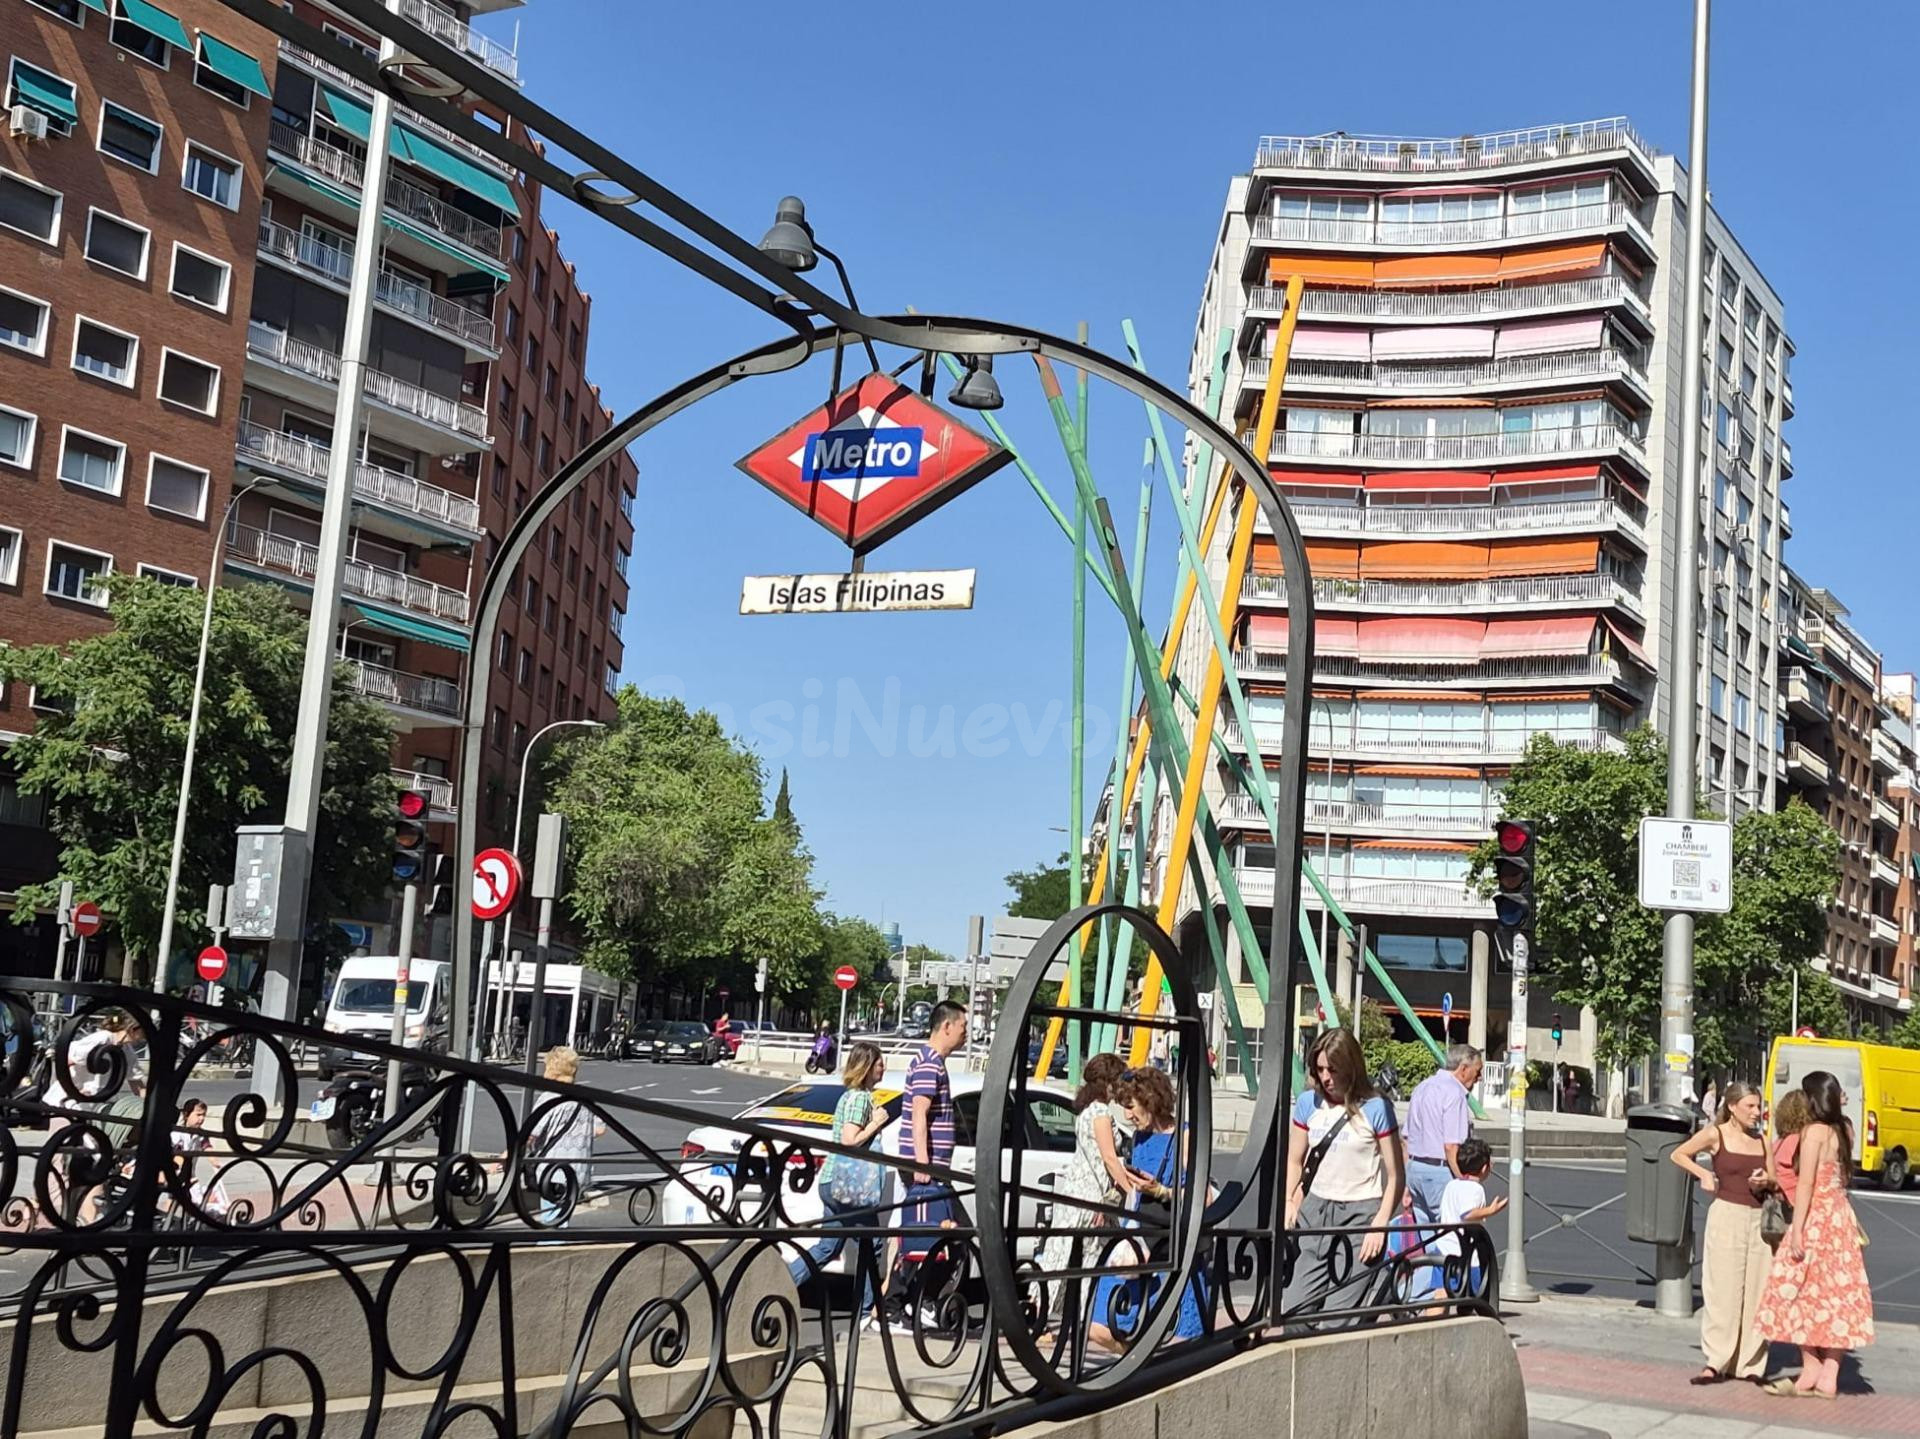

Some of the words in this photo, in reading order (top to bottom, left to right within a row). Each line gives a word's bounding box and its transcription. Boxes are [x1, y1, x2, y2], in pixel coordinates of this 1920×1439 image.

[812, 437, 913, 470] Metro
[768, 582, 827, 605] Islas
[836, 578, 945, 606] Filipinas
